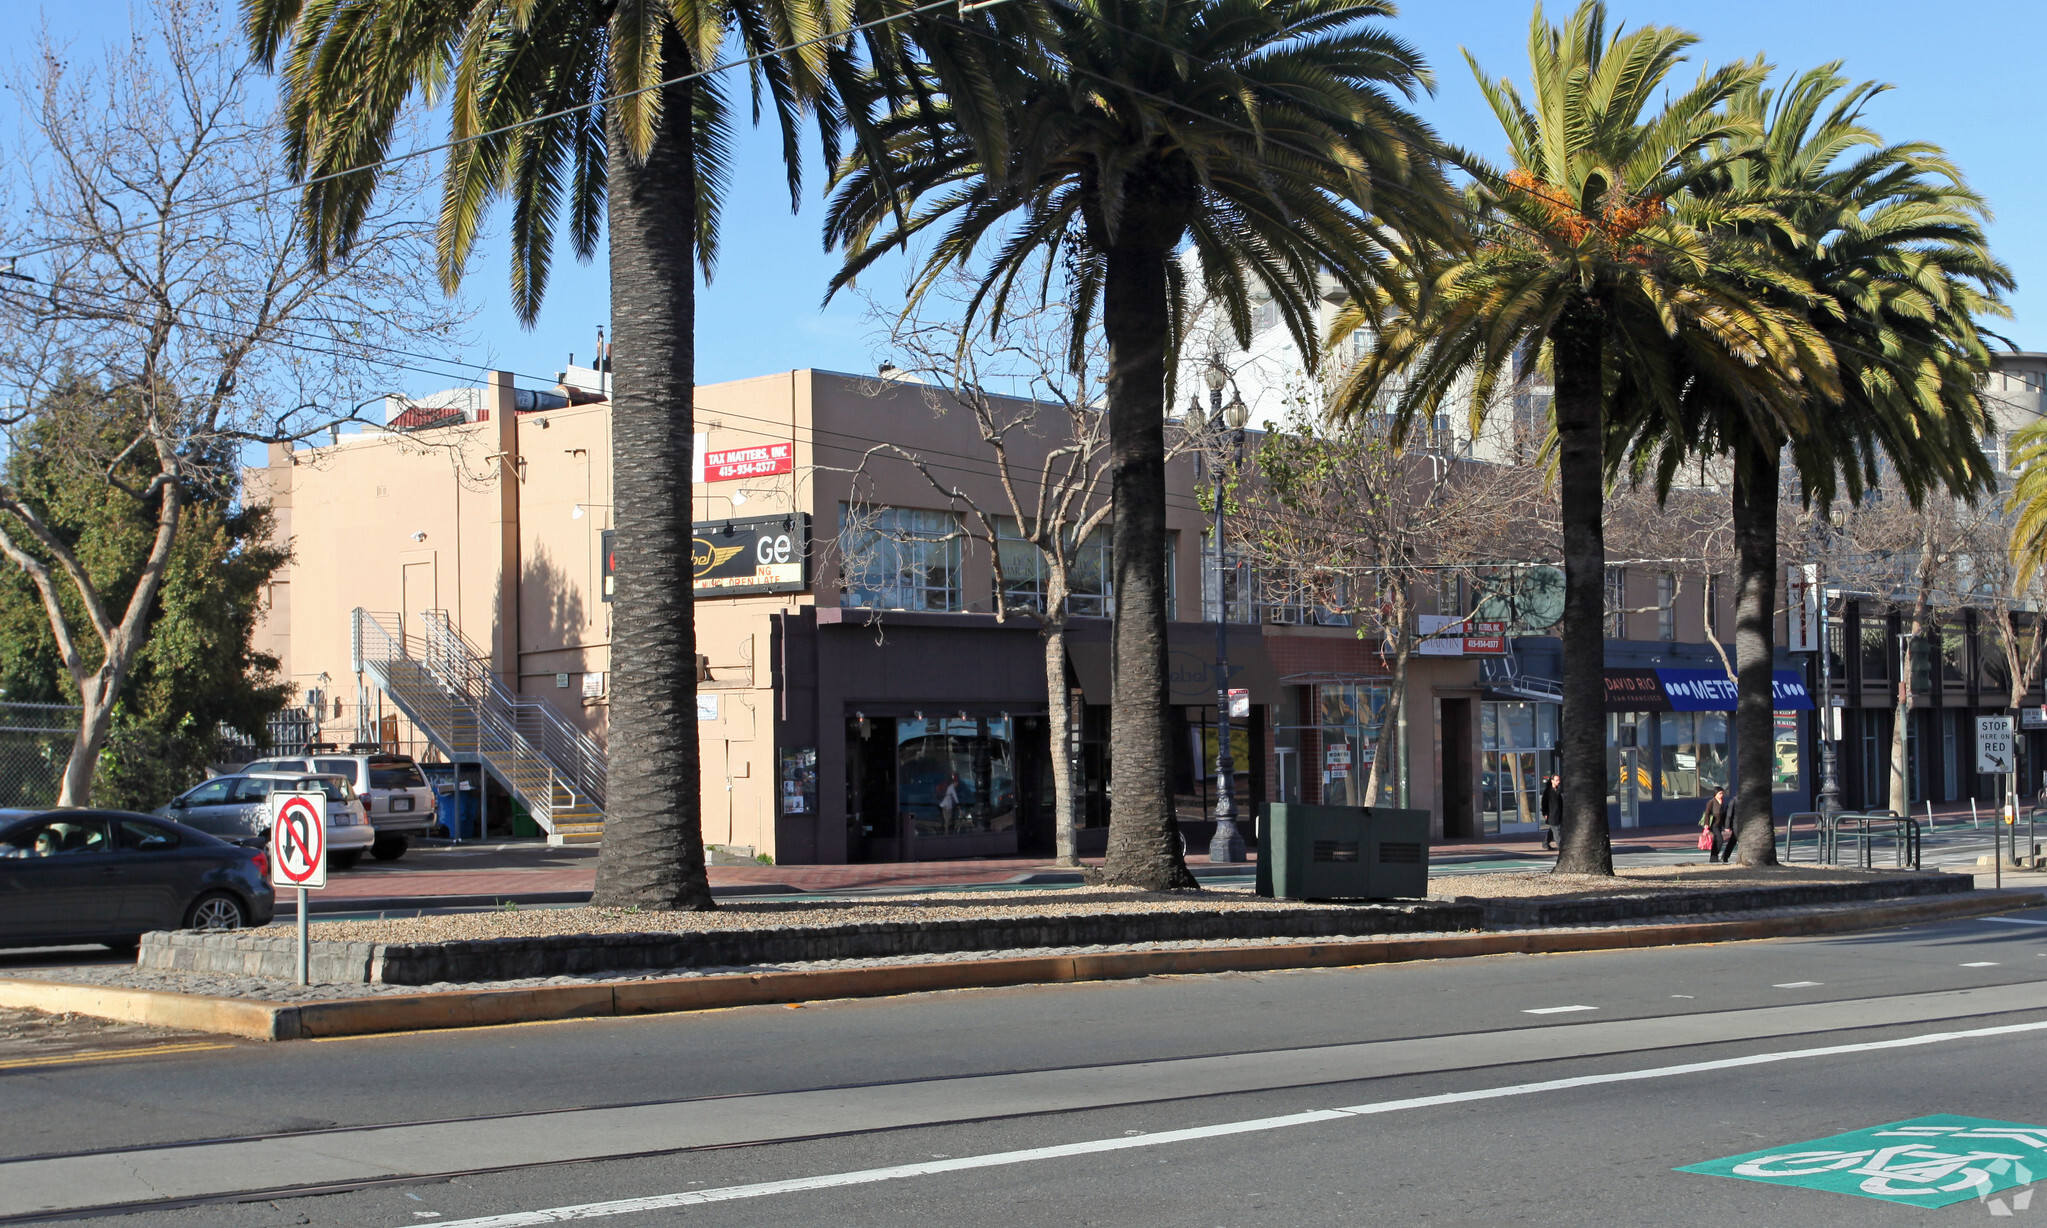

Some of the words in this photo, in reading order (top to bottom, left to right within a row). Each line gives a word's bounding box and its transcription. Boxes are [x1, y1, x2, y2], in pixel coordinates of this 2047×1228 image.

[708, 453, 725, 465] TAX
[727, 448, 769, 463] MATTERS,
[771, 446, 787, 458] INC
[719, 461, 776, 476] 415-934-0377
[1003, 566, 1034, 577] MARIN
[1604, 677, 1635, 691] DAVID
[1636, 677, 1656, 690] RIO
[1982, 721, 2008, 731] STOP
[1985, 742, 2006, 752] RED
